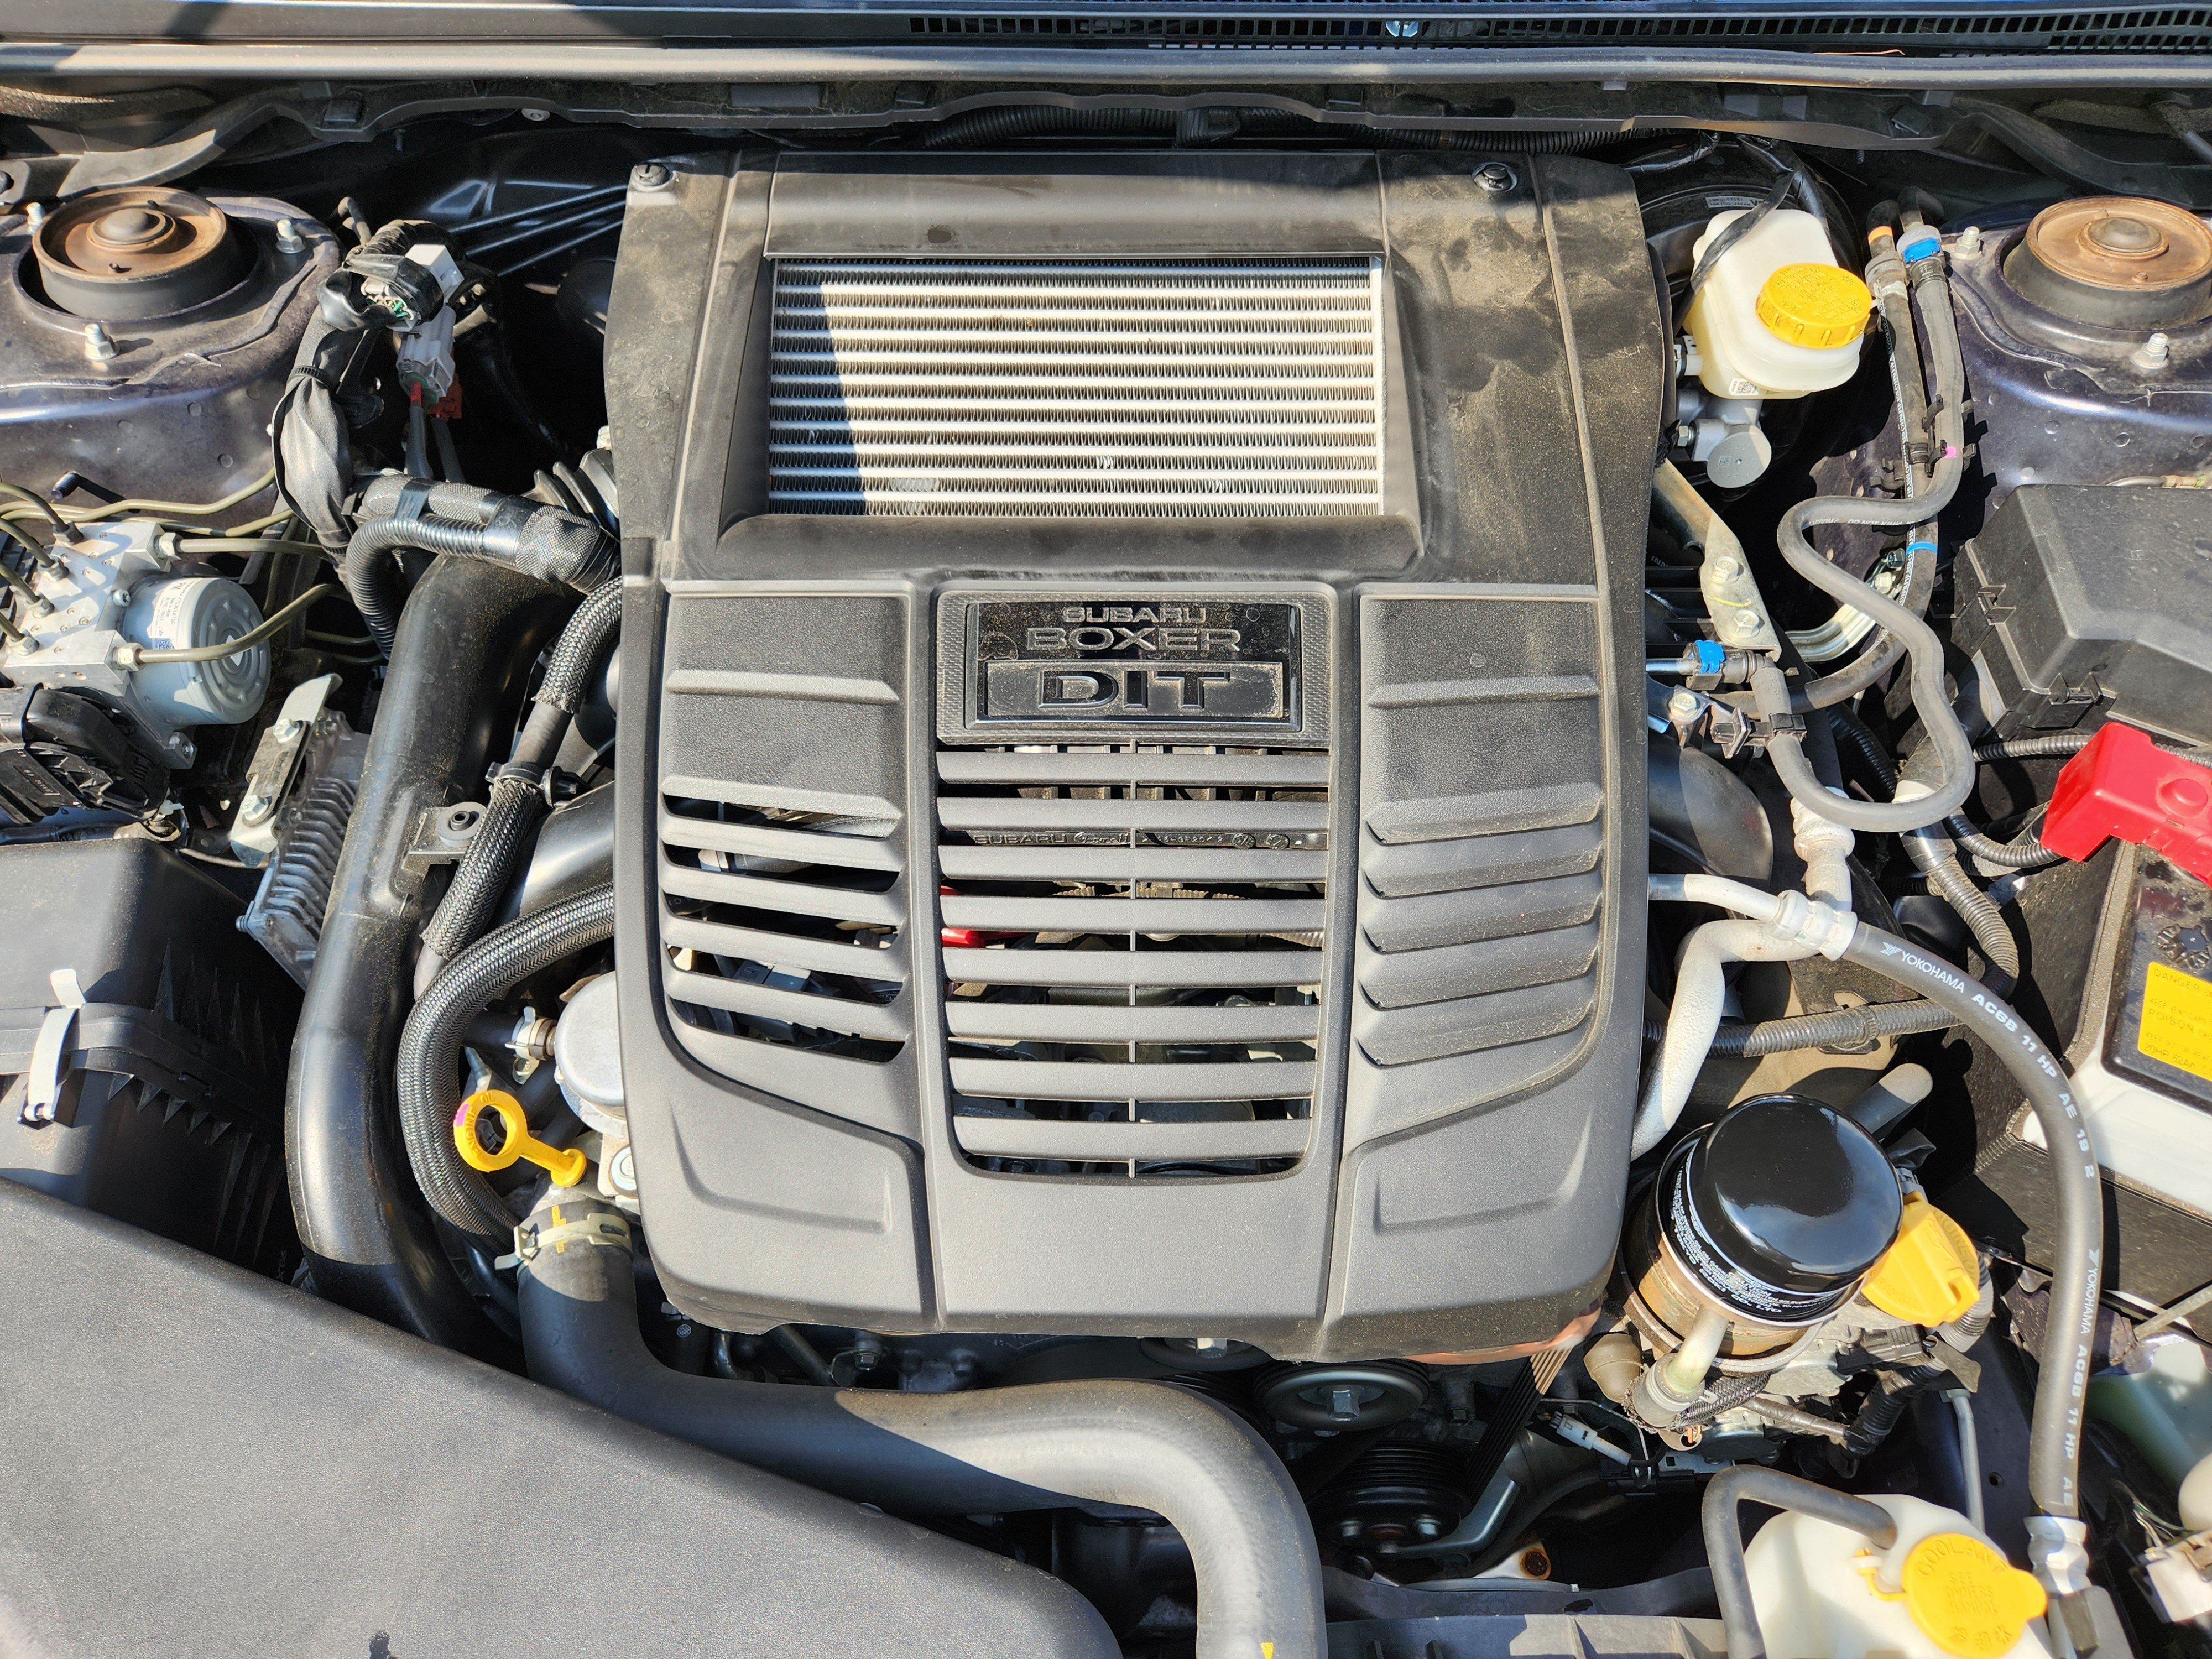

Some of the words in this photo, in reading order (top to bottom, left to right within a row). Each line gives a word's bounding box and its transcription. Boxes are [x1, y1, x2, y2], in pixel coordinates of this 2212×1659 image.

[1062, 607, 1206, 623] SUBARU
[1027, 627, 1240, 651] BOXER
[1038, 670, 1230, 708] DIT
[973, 834, 1067, 844] SUBARU
[2153, 968, 2200, 991] DANGER
[2149, 1008, 2194, 1032] POISON
[2145, 1042, 2169, 1059] 20HR
[1902, 951, 1965, 994] YOKOHAMA
[1971, 993, 2018, 1033] AC6B
[2022, 1034, 2038, 1053] 11
[2036, 1054, 2057, 1078] HP
[2058, 1093, 2078, 1119] AE
[2084, 1164, 2095, 1179] 2
[465, 1106, 483, 1159] ENGINE
[479, 1091, 494, 1104] OIL
[1672, 1224, 1697, 1265] TOKYO
[1698, 1267, 1726, 1292] ROKI
[1709, 1259, 1734, 1281] GASKET
[1728, 1271, 1772, 1297] CAUTION
[2080, 1267, 2098, 1334] YOKOHAMA
[2072, 1344, 2088, 1398] AC6B
[2067, 1407, 2078, 1425] 11
[2065, 1432, 2075, 1459] HP
[2063, 1475, 2073, 1507] AE
[1914, 1538, 2008, 1575] COOLANT
[1948, 1572, 1974, 1585] SEE
[1946, 1585, 1994, 1598] OWNERS
[1948, 1600, 1998, 1615] MANUAL
